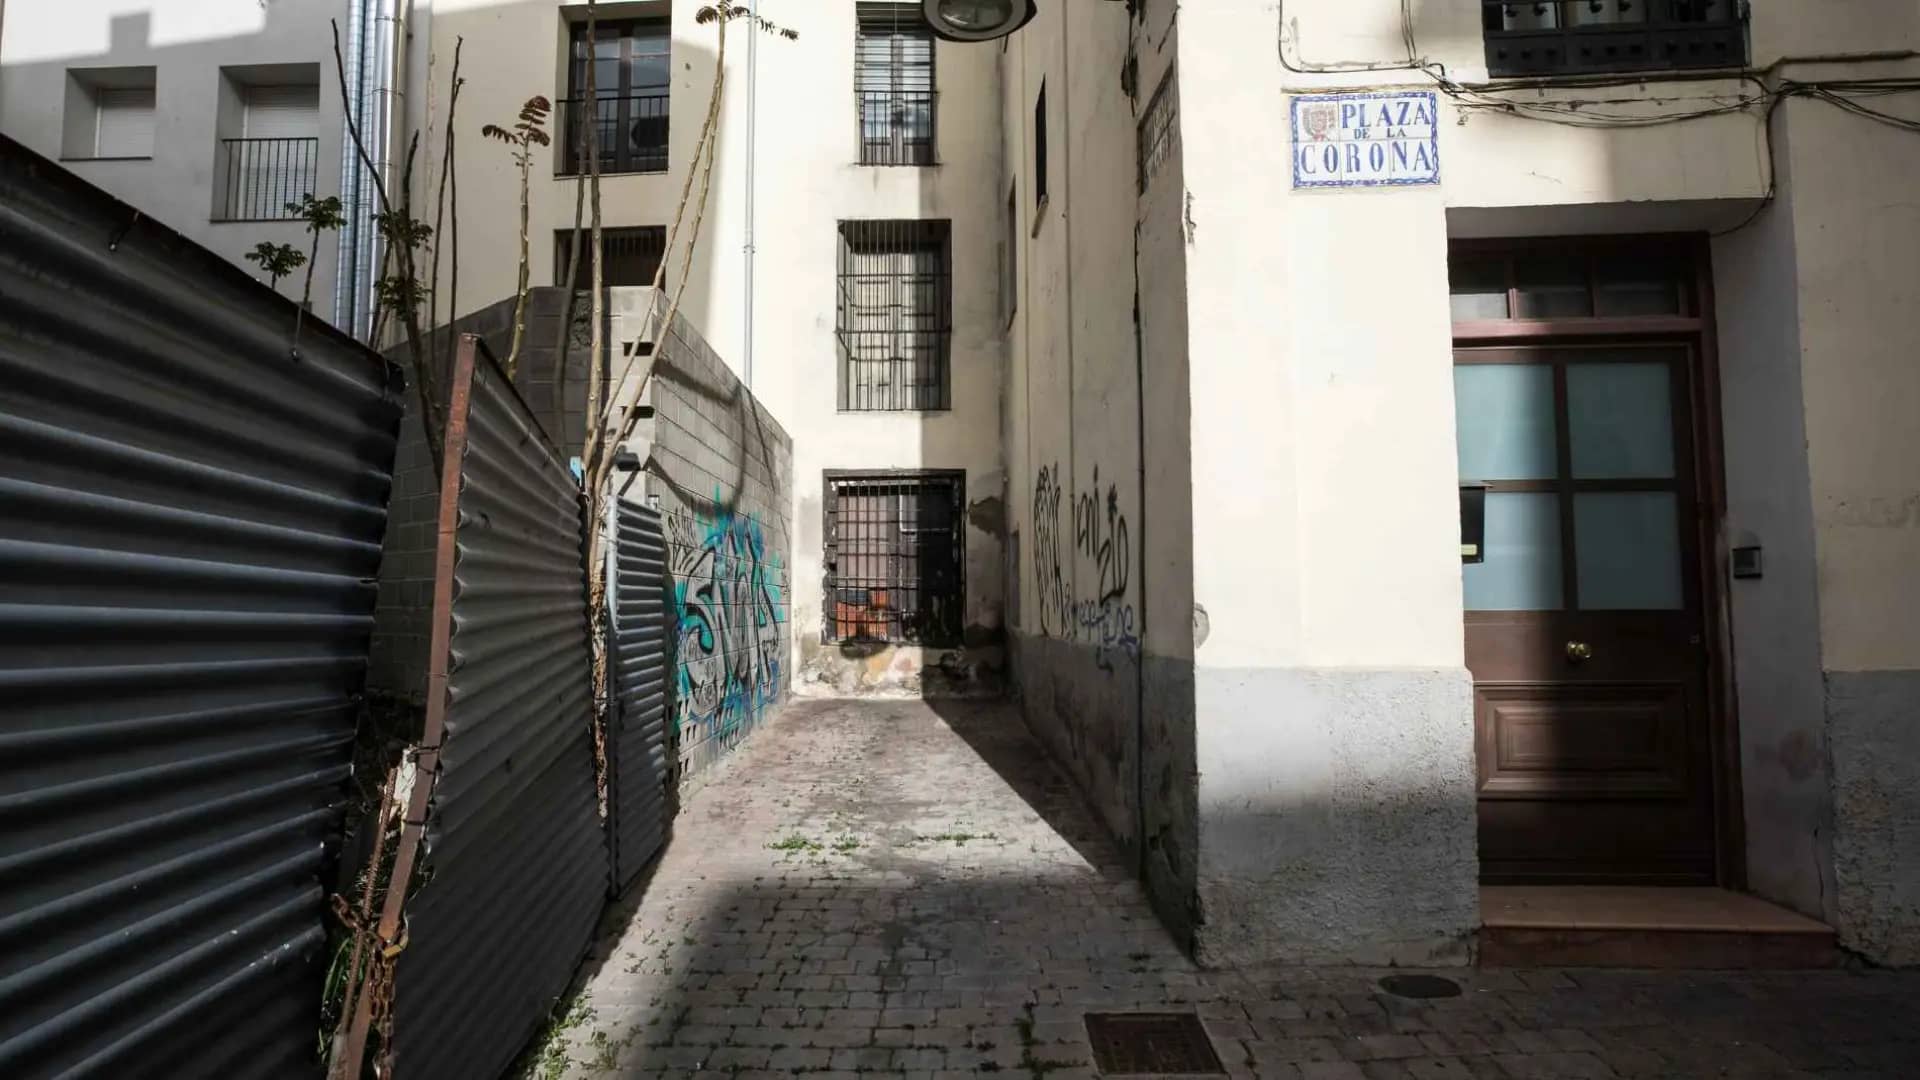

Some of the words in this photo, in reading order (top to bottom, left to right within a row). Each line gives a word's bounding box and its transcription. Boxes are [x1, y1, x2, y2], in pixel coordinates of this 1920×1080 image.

[1341, 101, 1431, 129] PLAZA
[1353, 127, 1371, 140] DE
[1386, 127, 1407, 138] LA
[1300, 140, 1432, 174] CORONA
